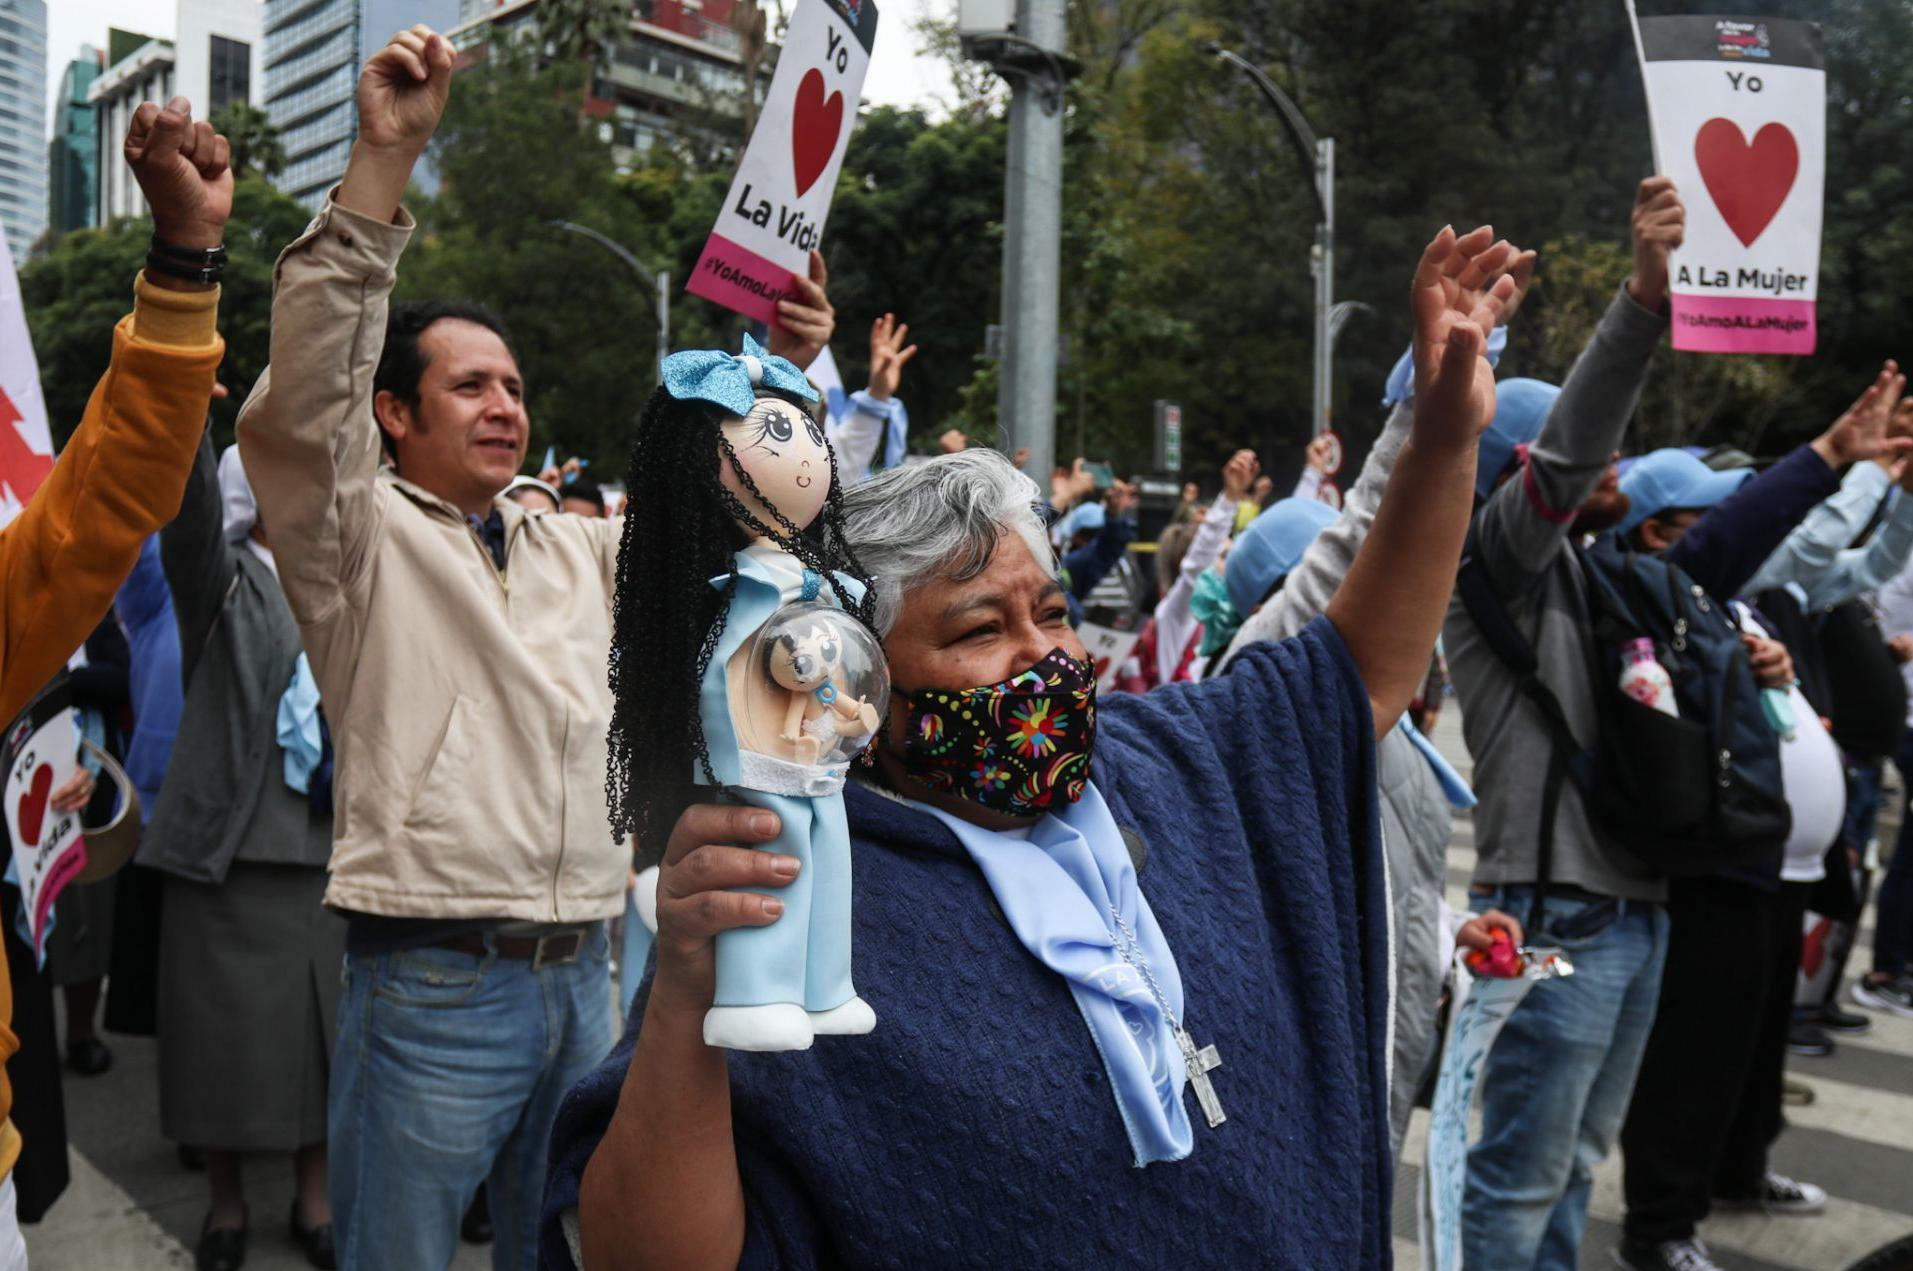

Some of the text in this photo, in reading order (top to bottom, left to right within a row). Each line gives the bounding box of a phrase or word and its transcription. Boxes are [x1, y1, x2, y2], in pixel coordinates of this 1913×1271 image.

[826, 24, 848, 74] Yo
[1726, 71, 1763, 93] Yo
[735, 183, 772, 229] La
[1678, 265, 1808, 296] A La Mujer
[1676, 310, 1809, 334] YoAmoALaMujer
